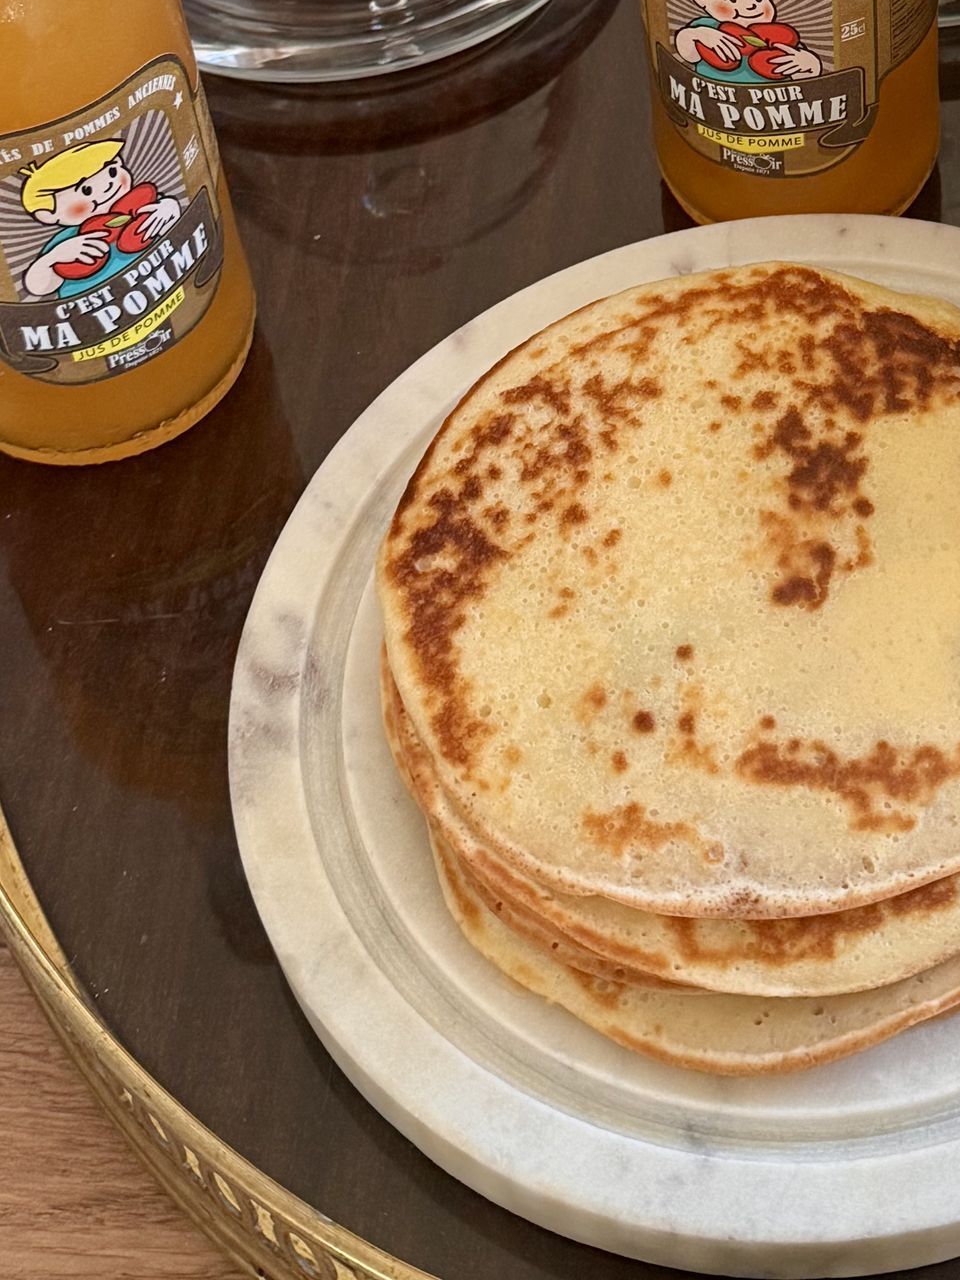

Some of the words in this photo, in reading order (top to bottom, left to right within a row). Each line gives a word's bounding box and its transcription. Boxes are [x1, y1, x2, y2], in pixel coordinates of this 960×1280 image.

[840, 22, 866, 39] 25cl
[31, 139, 55, 156] DE
[63, 106, 121, 146] POMMES
[127, 74, 177, 109] ANCIENNES
[669, 74, 706, 121] MA
[717, 94, 848, 131] POMME
[691, 76, 737, 103] C'EST
[748, 84, 804, 104] POUR
[701, 126, 723, 142] JUS
[726, 133, 744, 146] DE
[748, 136, 802, 148] POMME
[20, 321, 82, 351] MA
[92, 222, 209, 335] POMME
[55, 285, 116, 320] C'EST
[123, 239, 176, 288] POUR
[79, 344, 106, 361] JUS
[110, 331, 130, 348] DE
[134, 291, 184, 335] POMME
